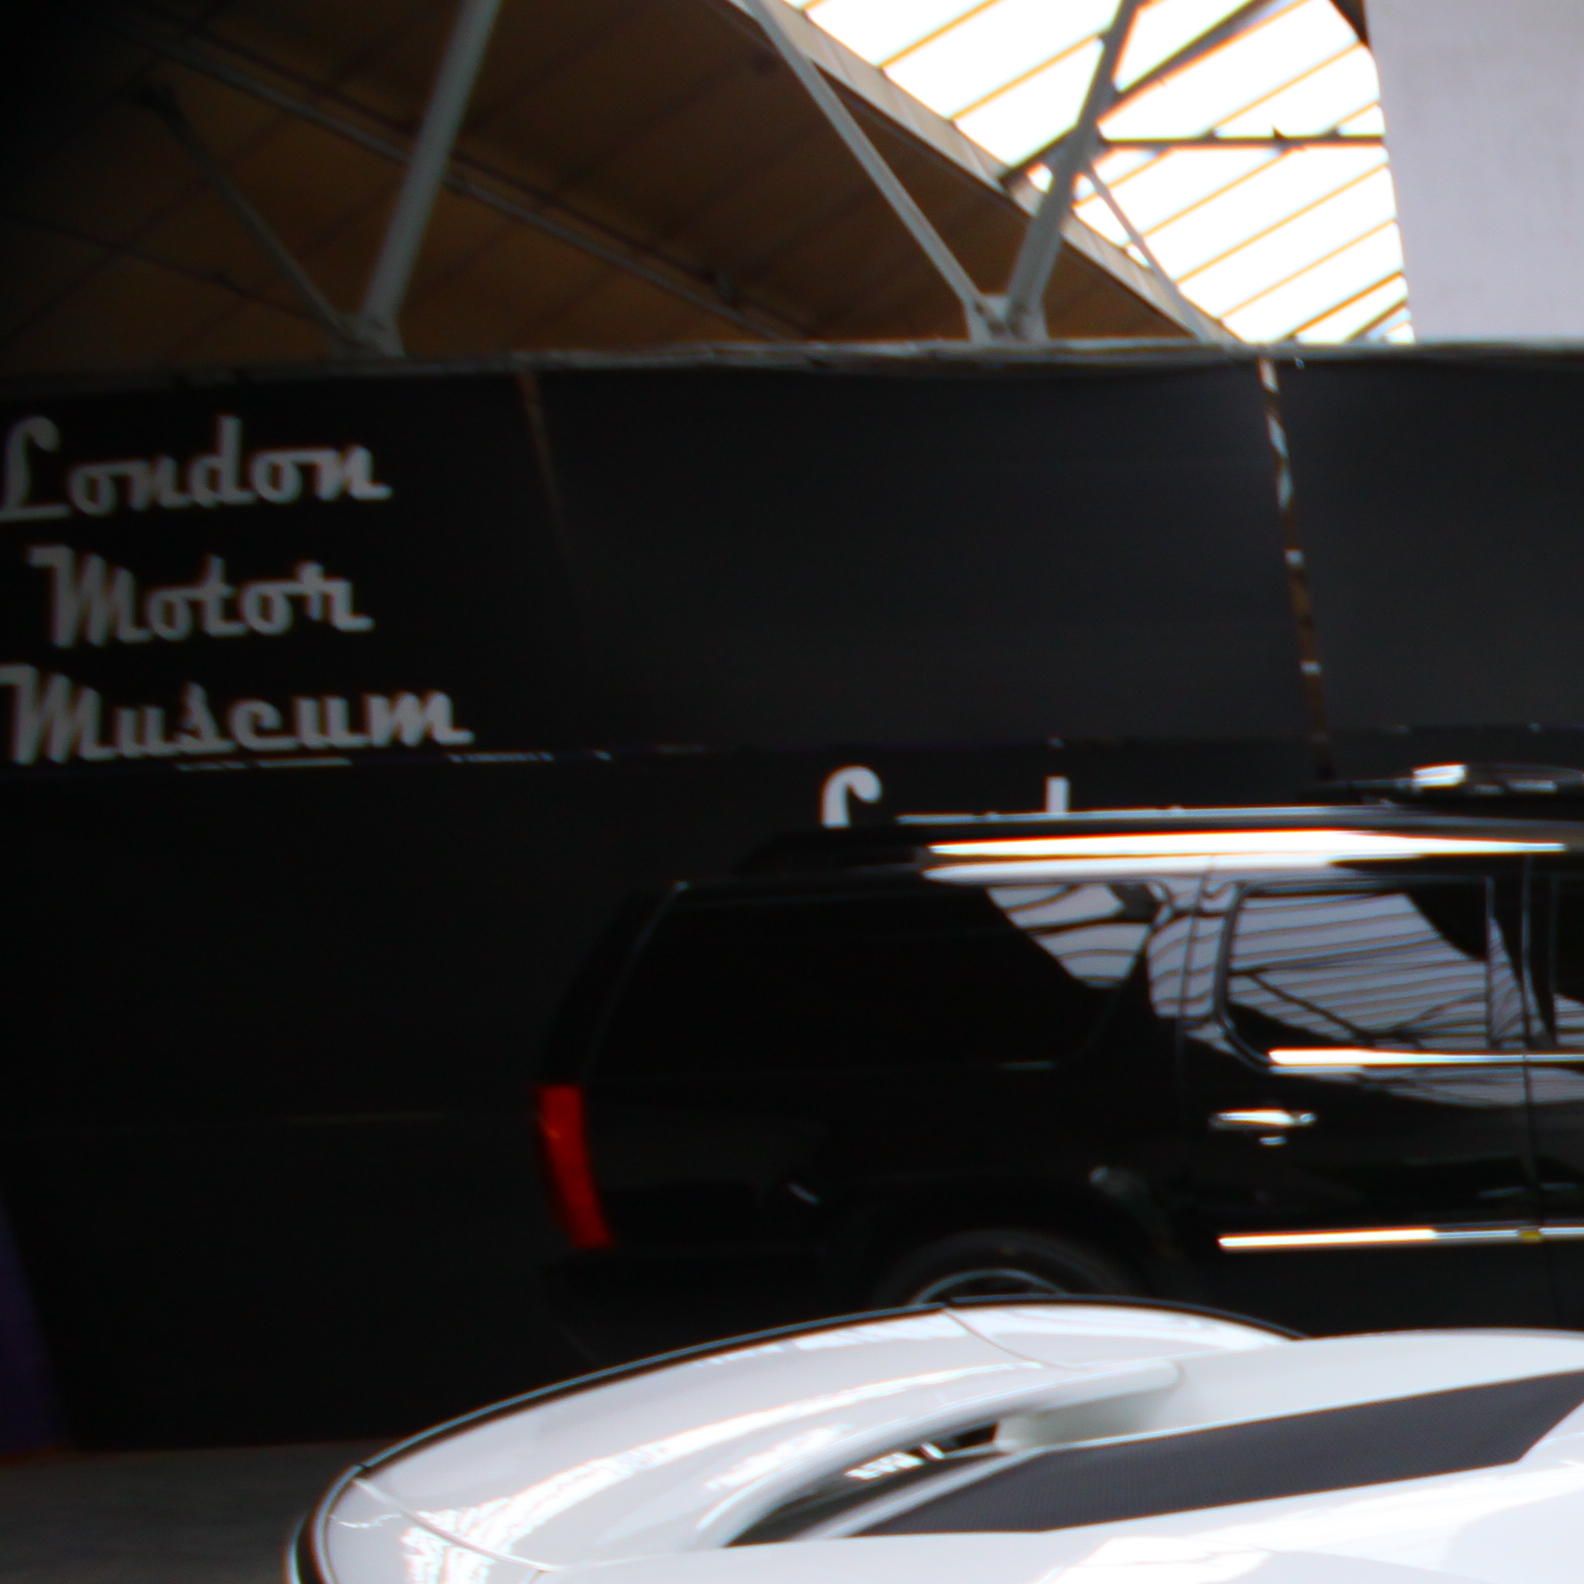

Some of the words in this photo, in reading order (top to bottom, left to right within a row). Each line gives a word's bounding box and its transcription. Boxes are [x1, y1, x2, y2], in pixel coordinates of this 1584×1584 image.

[0, 416, 392, 520] London
[29, 545, 374, 647] Motor
[0, 666, 475, 764] Museum
